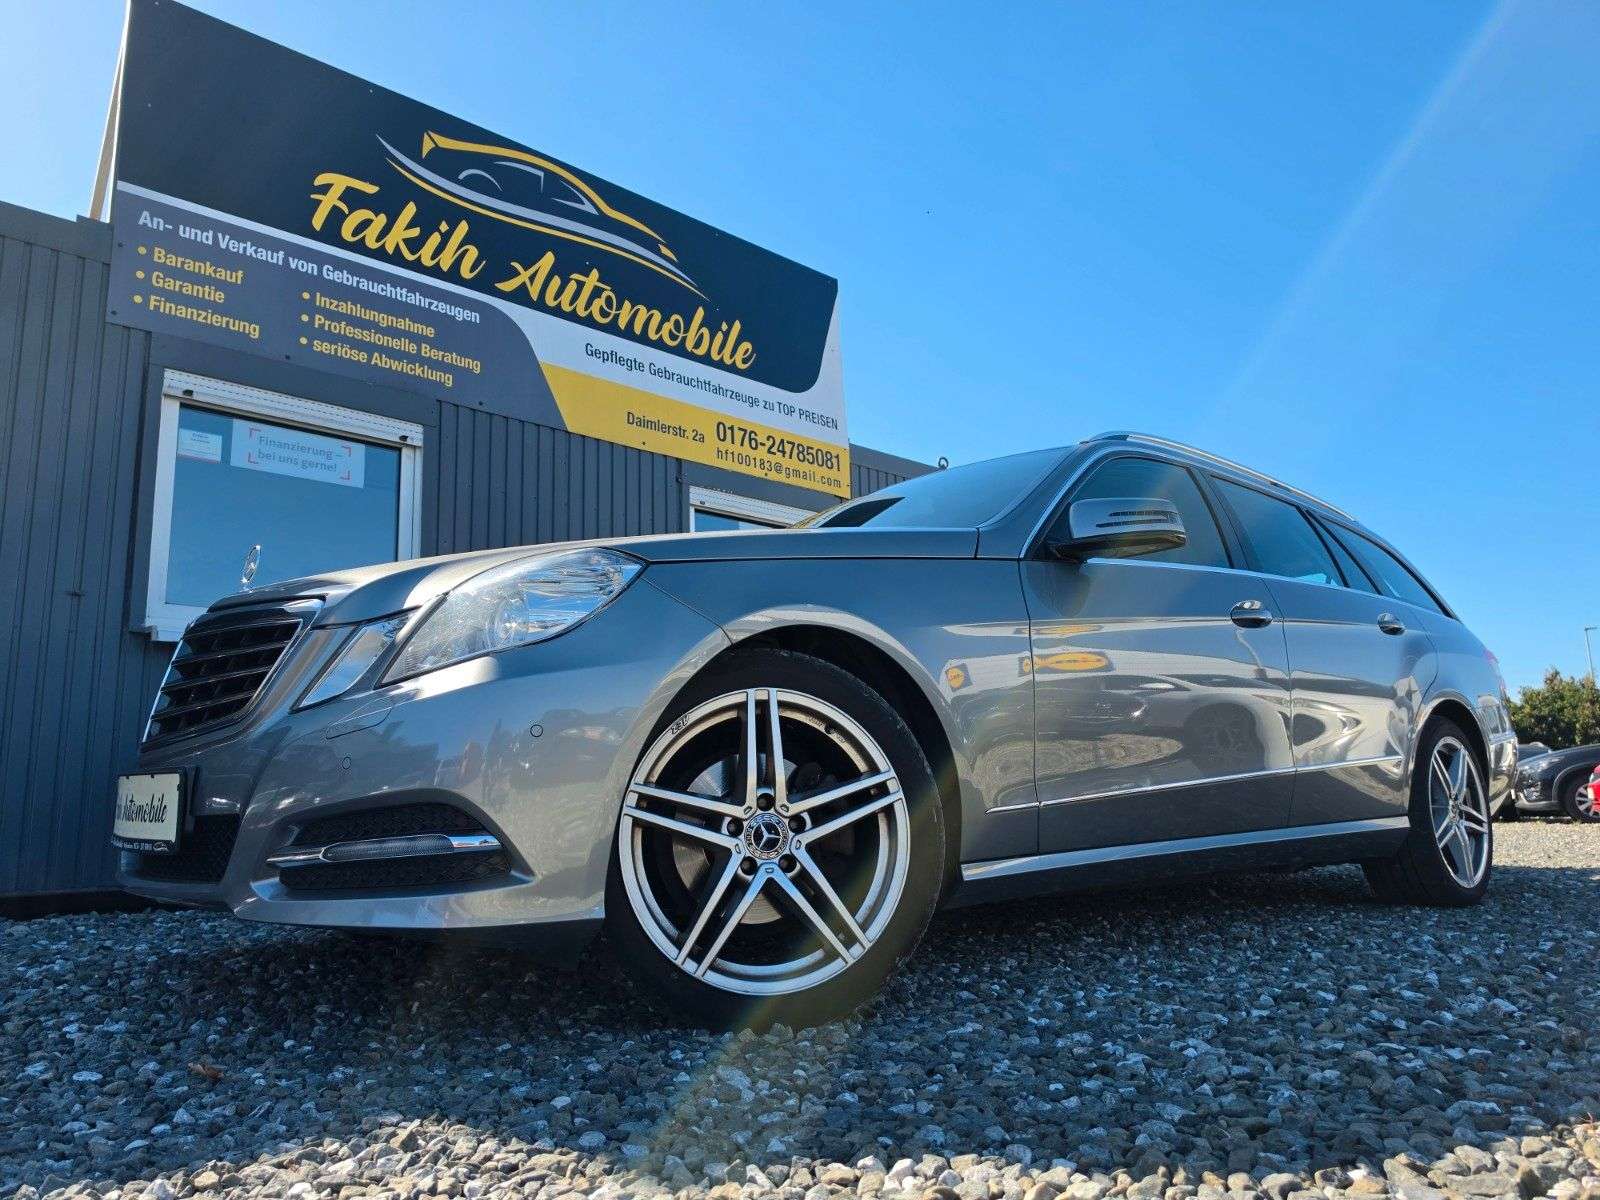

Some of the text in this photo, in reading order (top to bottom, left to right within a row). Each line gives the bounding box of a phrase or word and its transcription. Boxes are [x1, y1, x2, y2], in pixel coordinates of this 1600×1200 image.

[138, 210, 481, 324] An- und Verkauf von Gebrauchtfahrzeugen
[151, 271, 225, 303] Garantie
[153, 246, 244, 284] Barankauf
[310, 172, 757, 370] Fakih Automobile
[149, 295, 260, 339] Finanzierung
[315, 292, 436, 338] Inzahlungnahme
[313, 339, 453, 387] seriöse Abwicklung
[314, 314, 481, 374] Professionelle Beratung
[584, 342, 839, 430] Gepflegte Gebrauchtfahrzeuge zu TOP PREISEN
[259, 436, 333, 460] Finanzierung
[627, 411, 706, 444] Daimlerstr. 2a
[716, 421, 841, 472] 0176-24785081
[258, 448, 276, 461] bei
[280, 455, 299, 466] uns
[716, 447, 841, 488] hf100183@gmail.com
